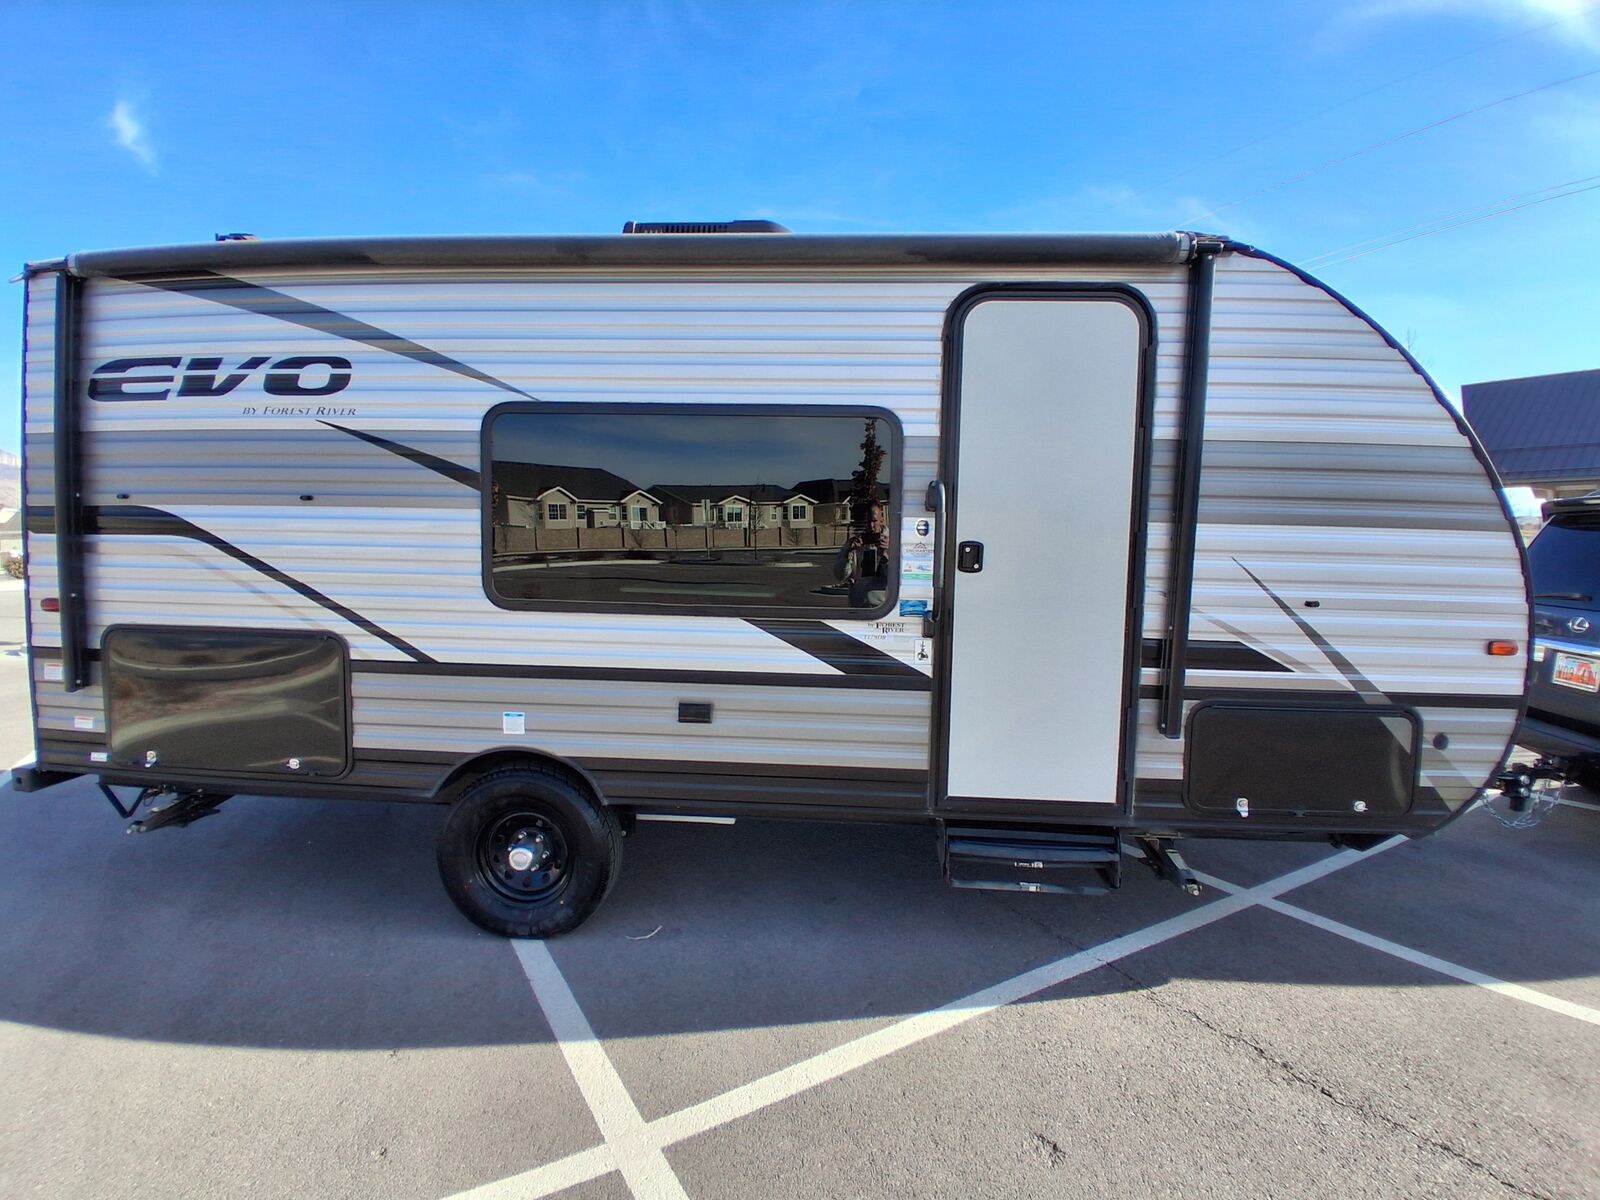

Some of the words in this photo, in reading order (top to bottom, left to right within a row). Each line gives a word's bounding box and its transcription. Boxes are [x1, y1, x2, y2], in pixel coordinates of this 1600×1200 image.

[88, 356, 352, 402] EVO
[242, 406, 257, 415] BY
[263, 406, 313, 415] FOREST
[316, 406, 357, 416] RIVER
